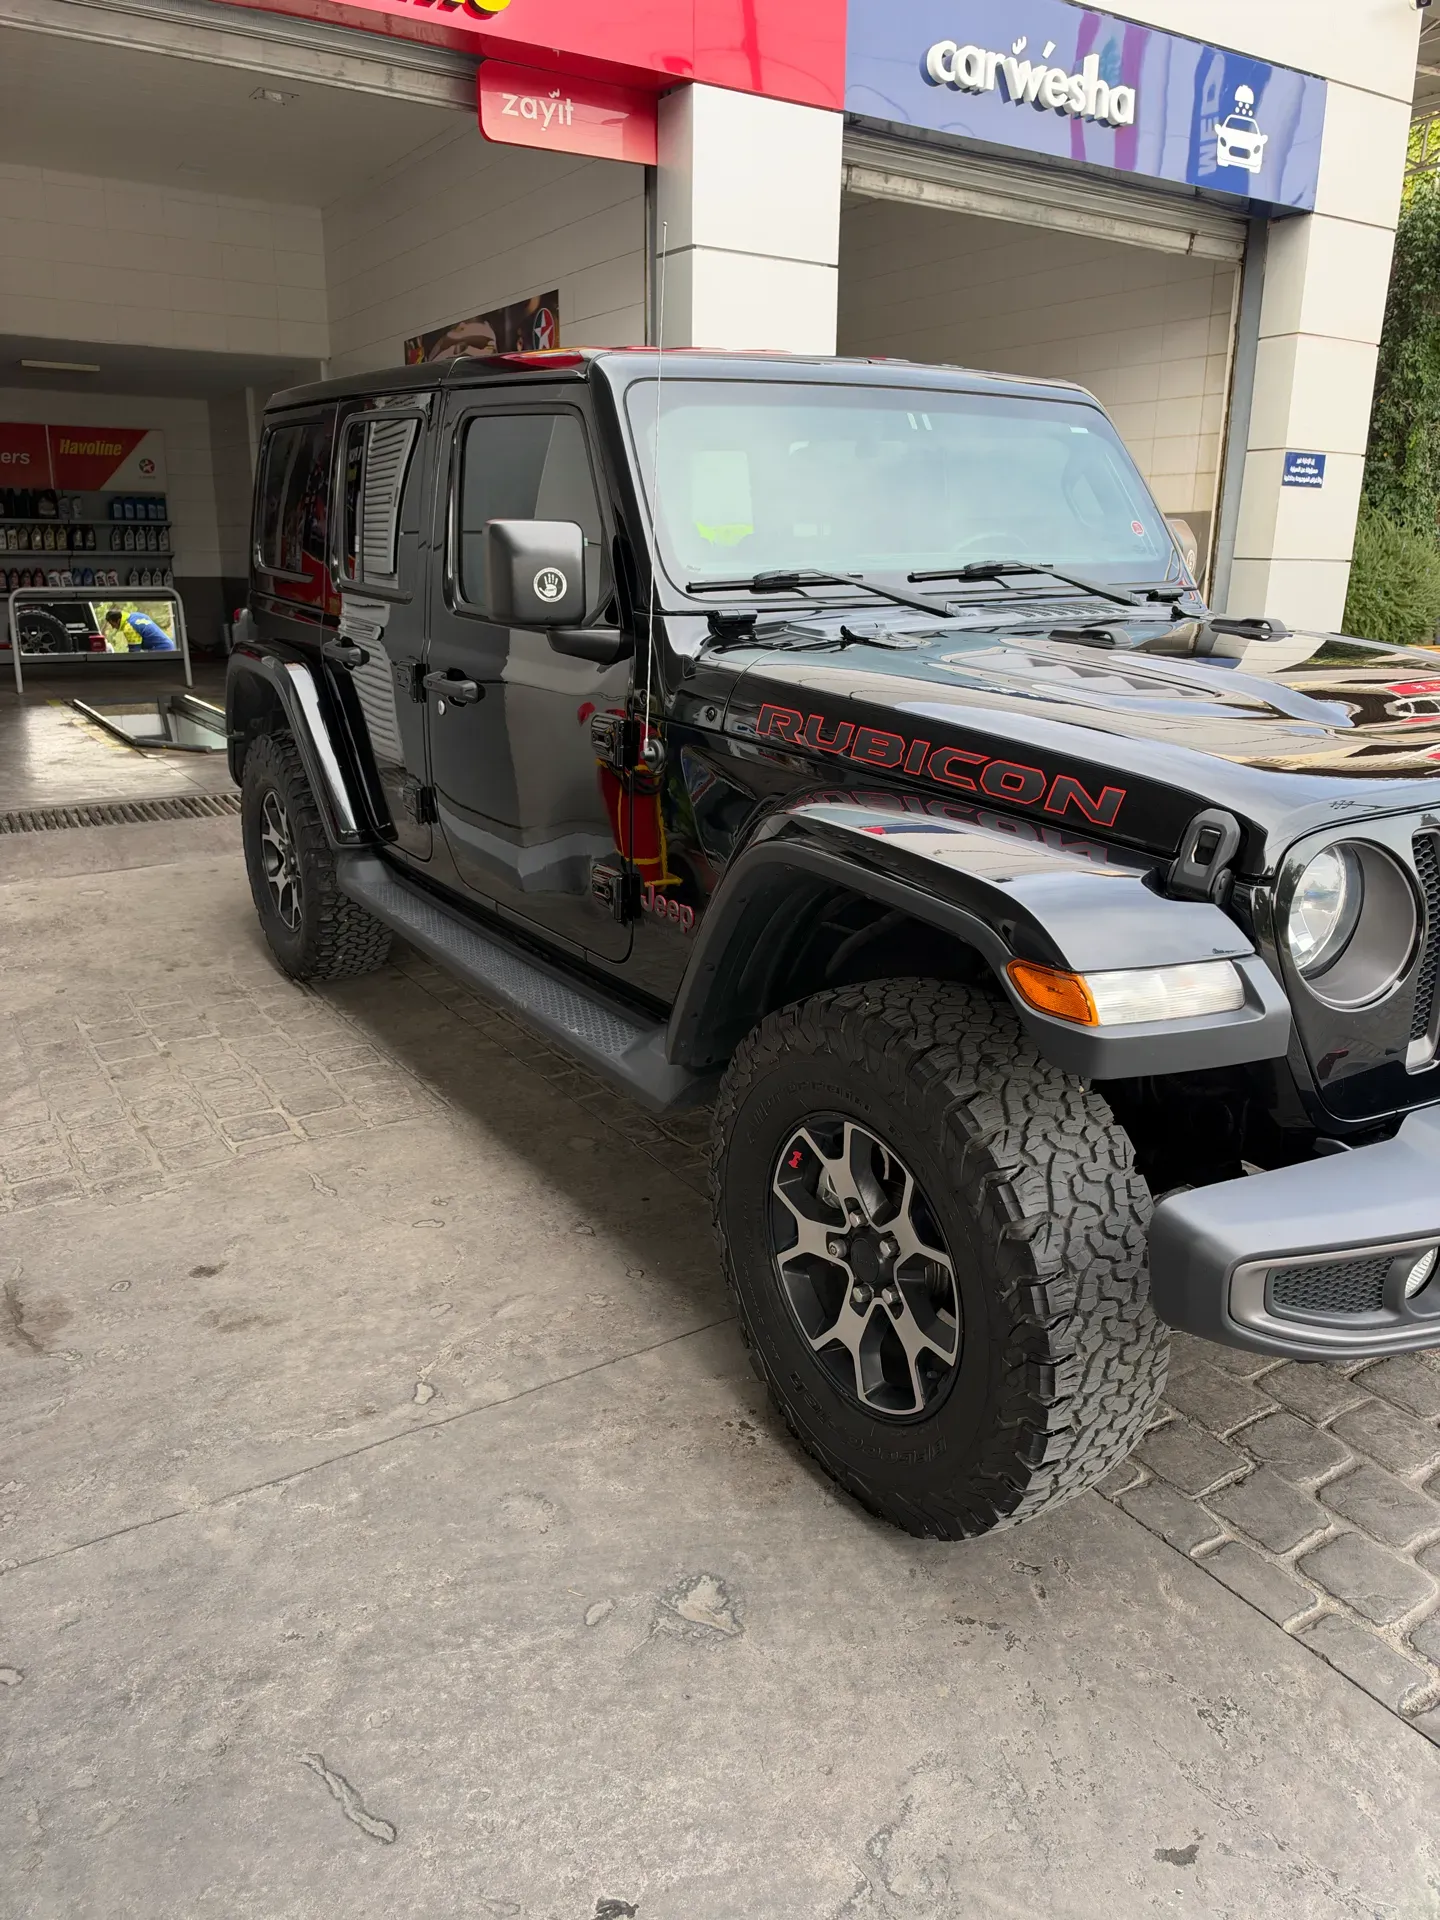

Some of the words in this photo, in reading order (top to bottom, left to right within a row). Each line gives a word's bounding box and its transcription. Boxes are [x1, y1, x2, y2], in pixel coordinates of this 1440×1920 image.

[60, 438, 122, 456] Havoline
[756, 703, 1127, 828] RUBICON
[640, 884, 695, 933] Jeep
